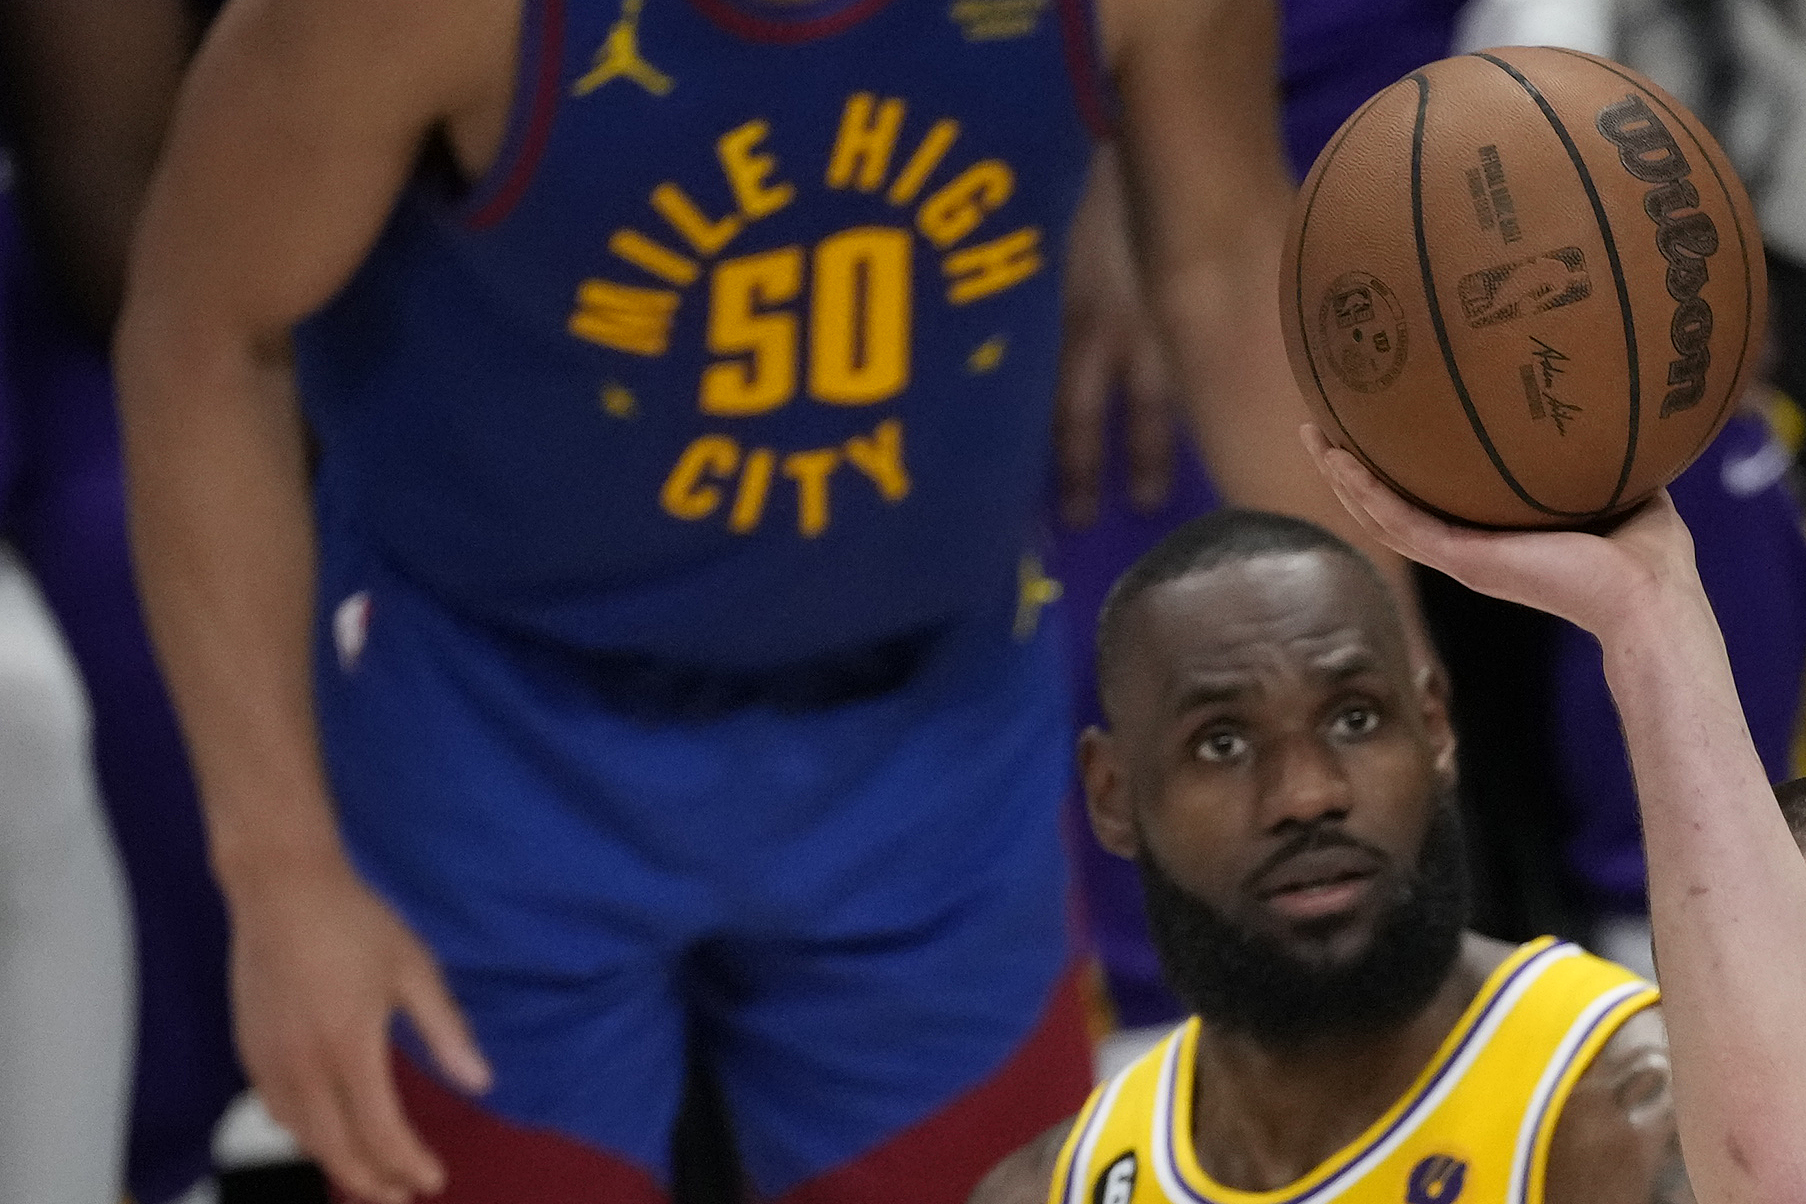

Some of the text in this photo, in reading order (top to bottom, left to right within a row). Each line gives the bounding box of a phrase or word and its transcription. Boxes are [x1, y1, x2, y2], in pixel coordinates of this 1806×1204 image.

[569, 92, 1044, 357] MILE HIGH
[699, 225, 913, 416] 50
[1595, 93, 1719, 419] Wilson
[660, 419, 911, 537] CITY
